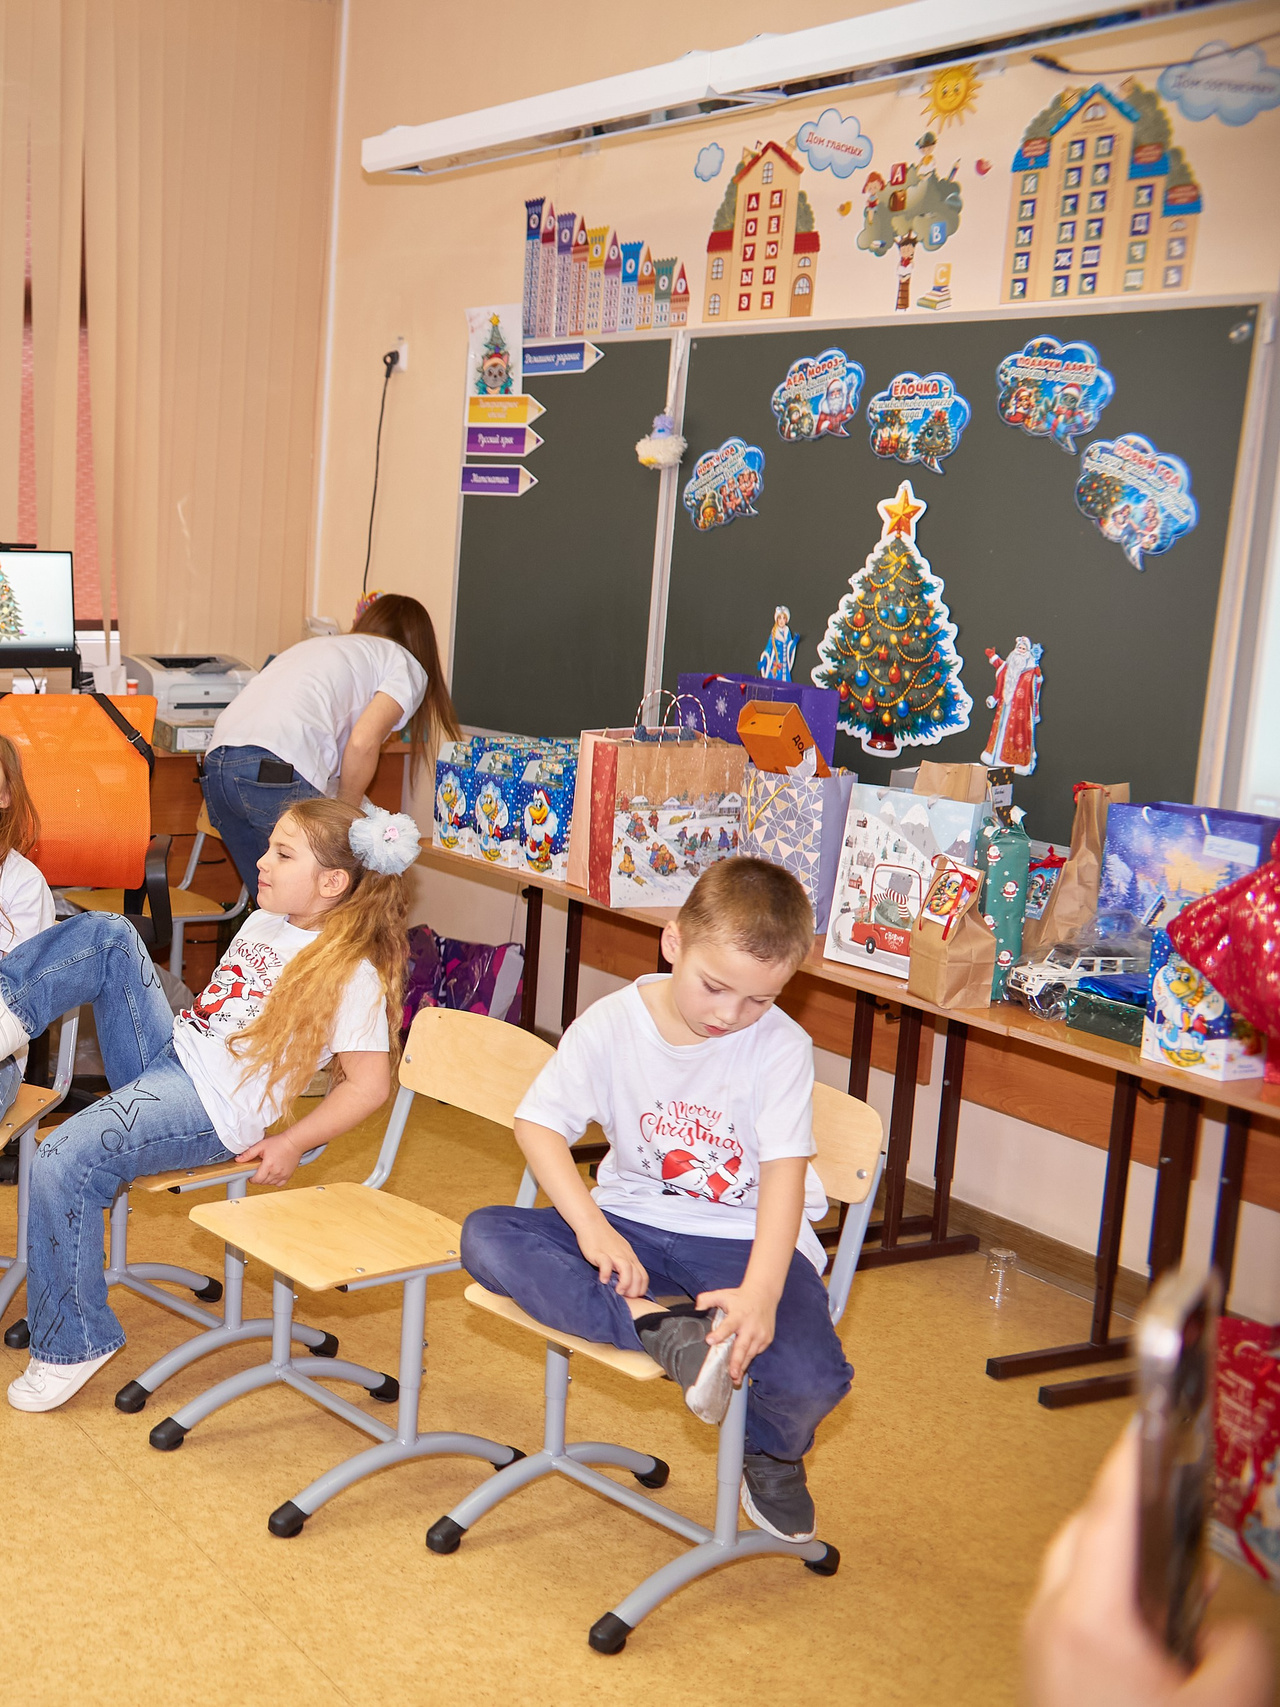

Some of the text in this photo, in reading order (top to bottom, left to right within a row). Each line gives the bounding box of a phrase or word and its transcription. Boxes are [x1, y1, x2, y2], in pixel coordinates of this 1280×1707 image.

[805, 131, 863, 157] Дом гласных
[1017, 357, 1062, 370] ПОДАРКИ
[785, 372, 805, 388] ДЕД
[893, 381, 940, 396] ЁЛОЧКА
[228, 938, 273, 991] Christma
[668, 1101, 722, 1127] Merry
[639, 1112, 743, 1157] Christmas
